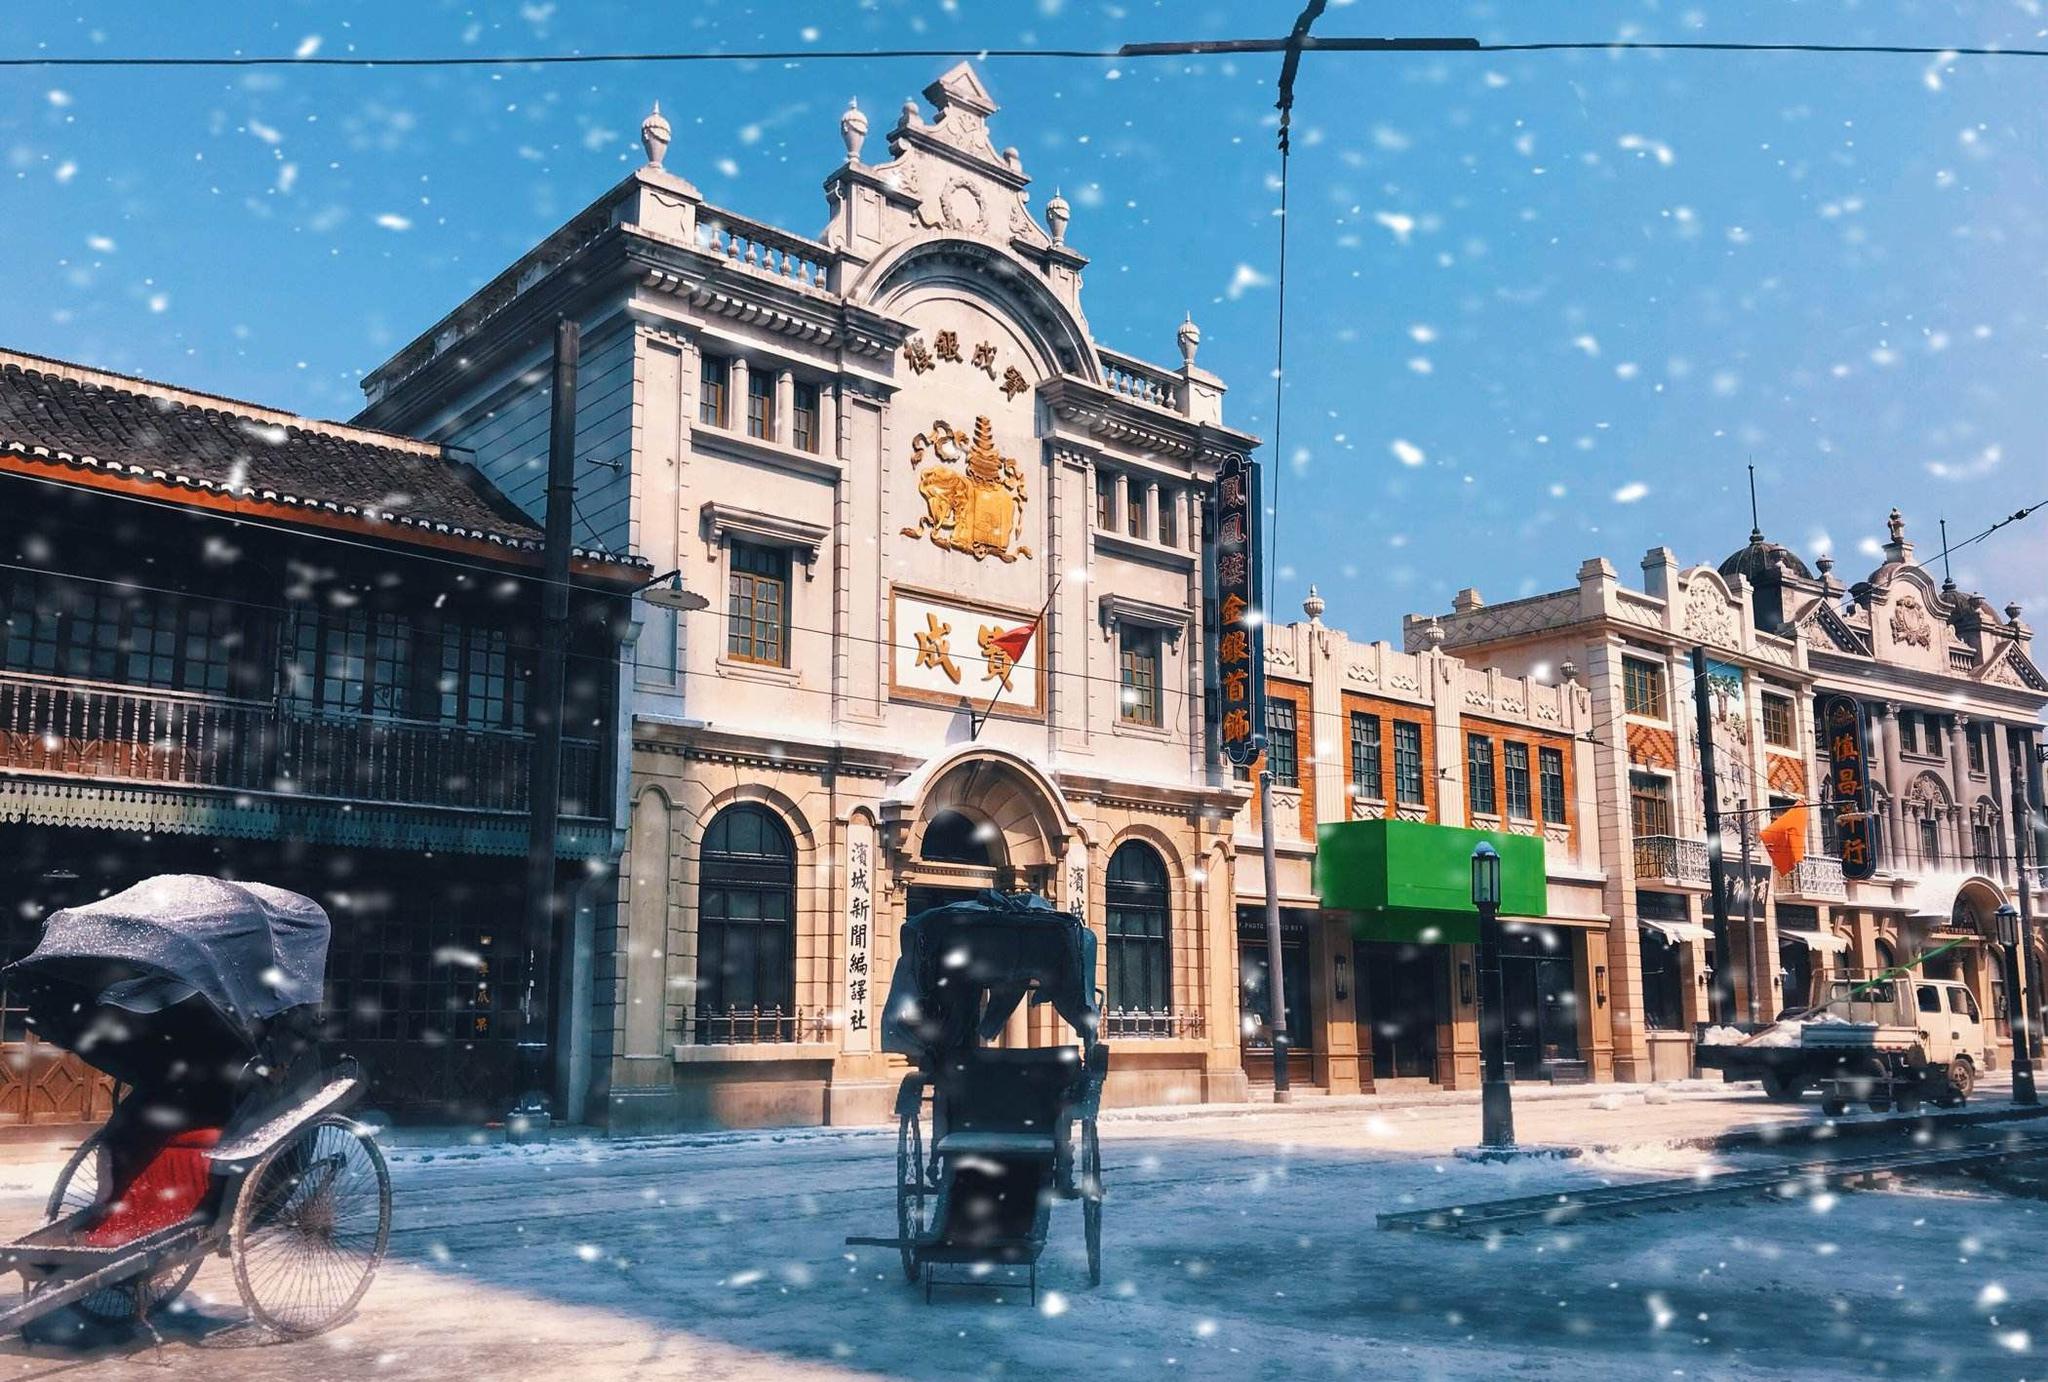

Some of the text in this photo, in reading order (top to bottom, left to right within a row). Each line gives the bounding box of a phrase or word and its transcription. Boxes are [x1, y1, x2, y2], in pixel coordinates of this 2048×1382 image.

[849, 842, 870, 1032] 濱城新聞編譯社
